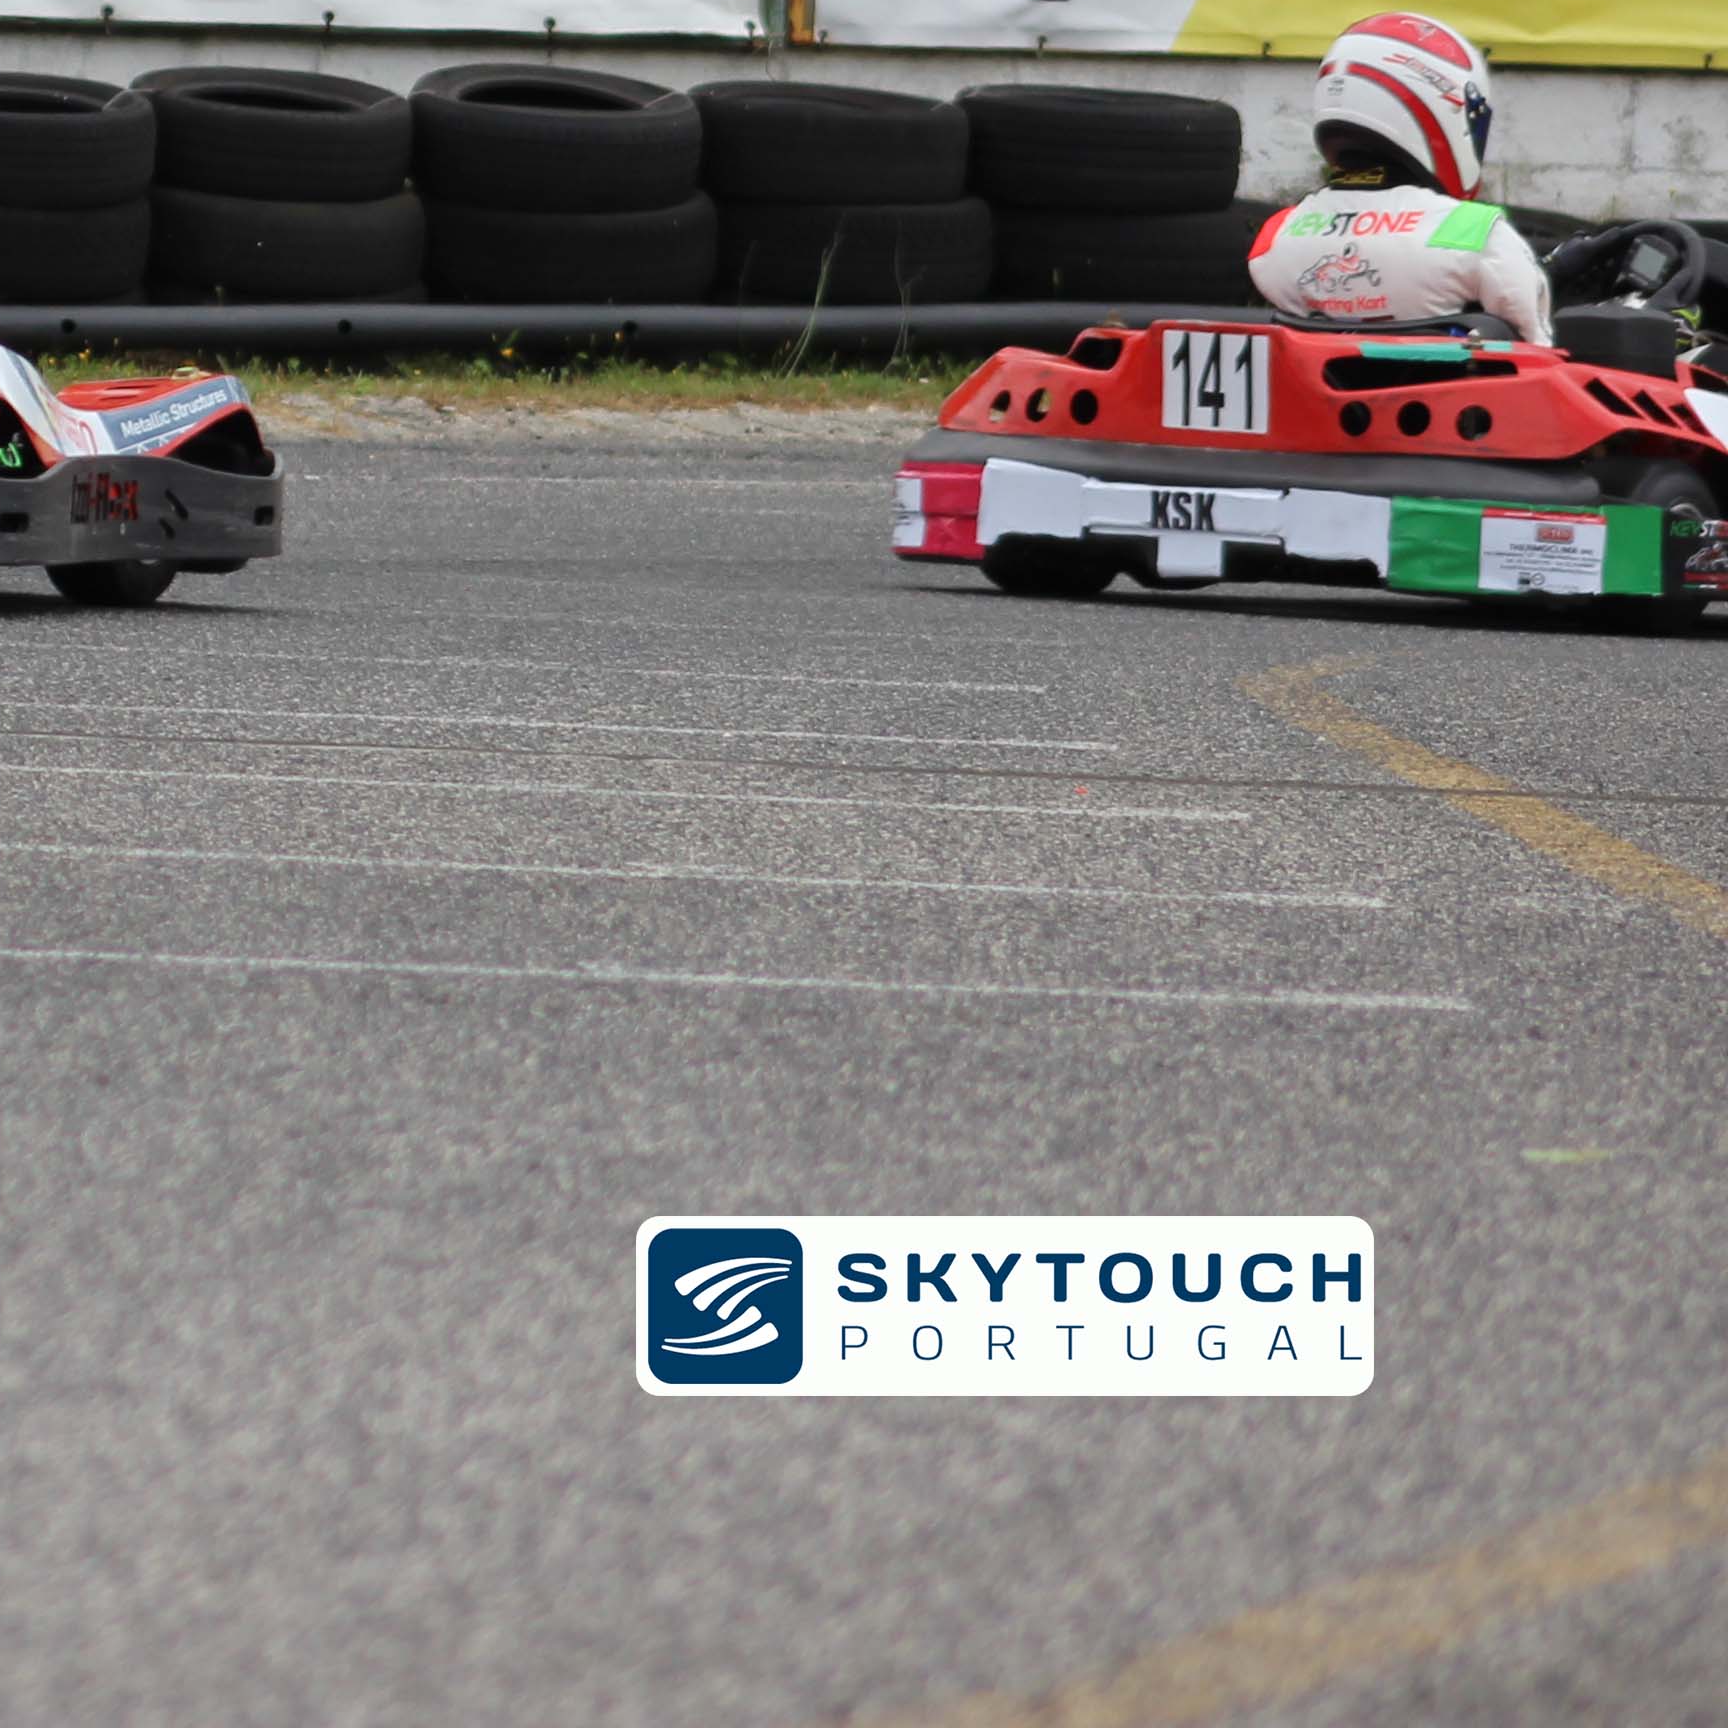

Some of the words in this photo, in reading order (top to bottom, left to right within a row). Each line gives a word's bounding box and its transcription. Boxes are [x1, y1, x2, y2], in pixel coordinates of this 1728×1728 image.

[1285, 211, 1424, 237] KEYSTONE
[1172, 332, 1253, 429] 141
[120, 410, 171, 439] Metallic
[169, 388, 228, 422] Structures
[1151, 491, 1216, 531] KSK
